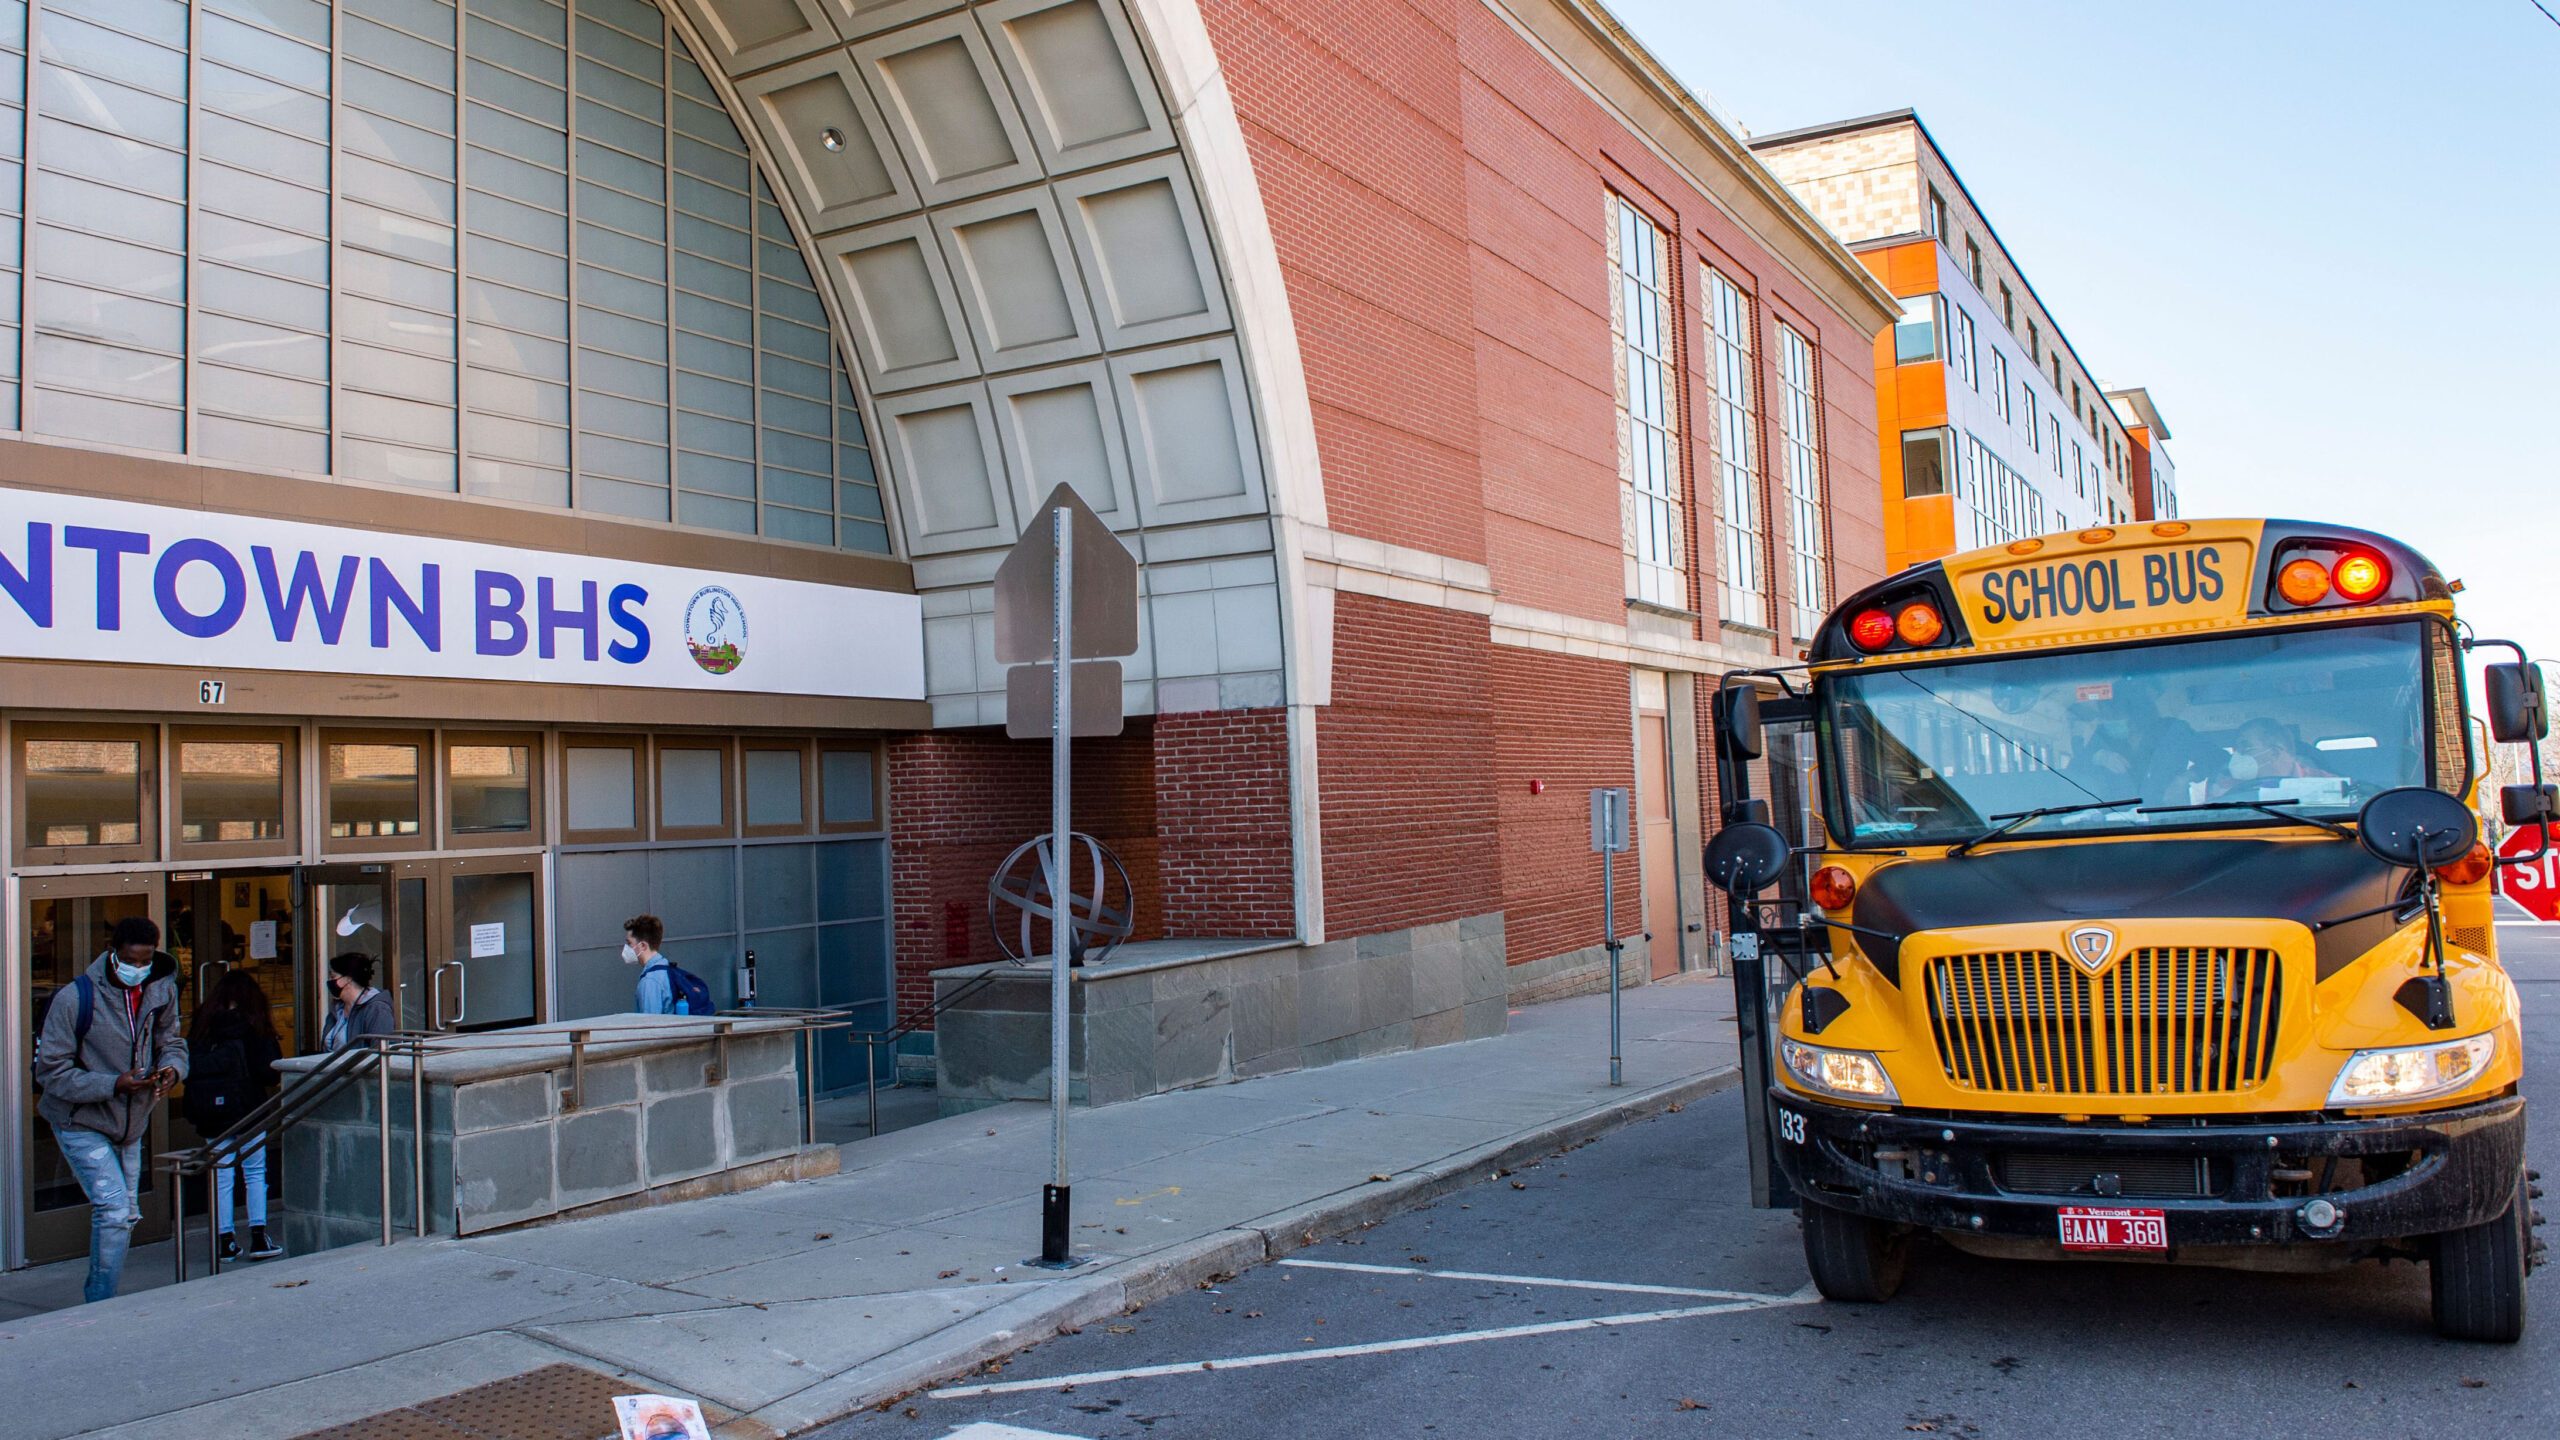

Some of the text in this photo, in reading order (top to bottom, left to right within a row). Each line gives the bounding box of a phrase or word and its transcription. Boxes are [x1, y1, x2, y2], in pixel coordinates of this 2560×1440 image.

[1982, 547, 2225, 625] SCHOOL BUS
[475, 569, 651, 664] BHS
[686, 595, 699, 634] DOWNTOWN
[201, 681, 223, 703] 67
[2514, 848, 2560, 890] ST
[1779, 1108, 1806, 1144] 133
[2087, 1207, 2131, 1217] Vermont
[2073, 1219, 2160, 1245] AAW 368
